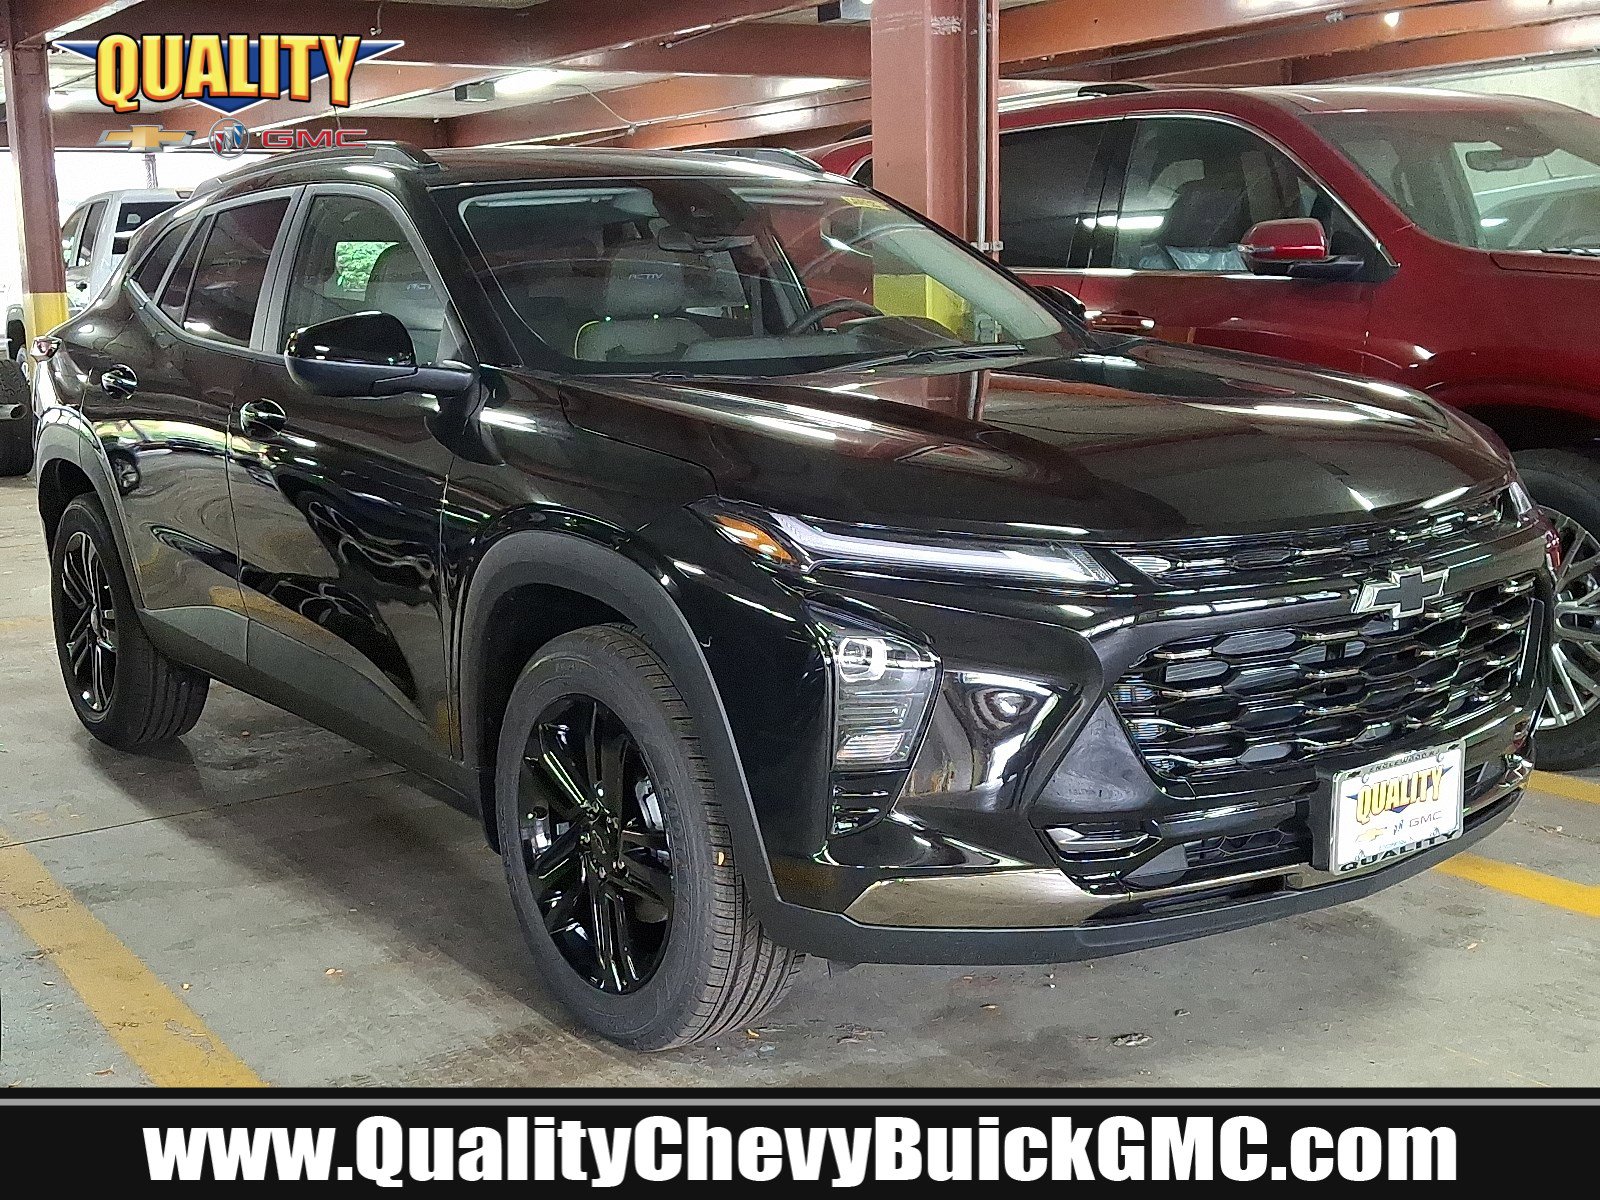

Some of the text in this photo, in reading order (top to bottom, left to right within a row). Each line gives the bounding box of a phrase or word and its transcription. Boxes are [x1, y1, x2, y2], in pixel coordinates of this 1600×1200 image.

[628, 272, 664, 281] ACTIV
[1355, 764, 1444, 825] QUALITY
[1409, 811, 1443, 828] GMC
[1339, 829, 1459, 872] QUALITY
